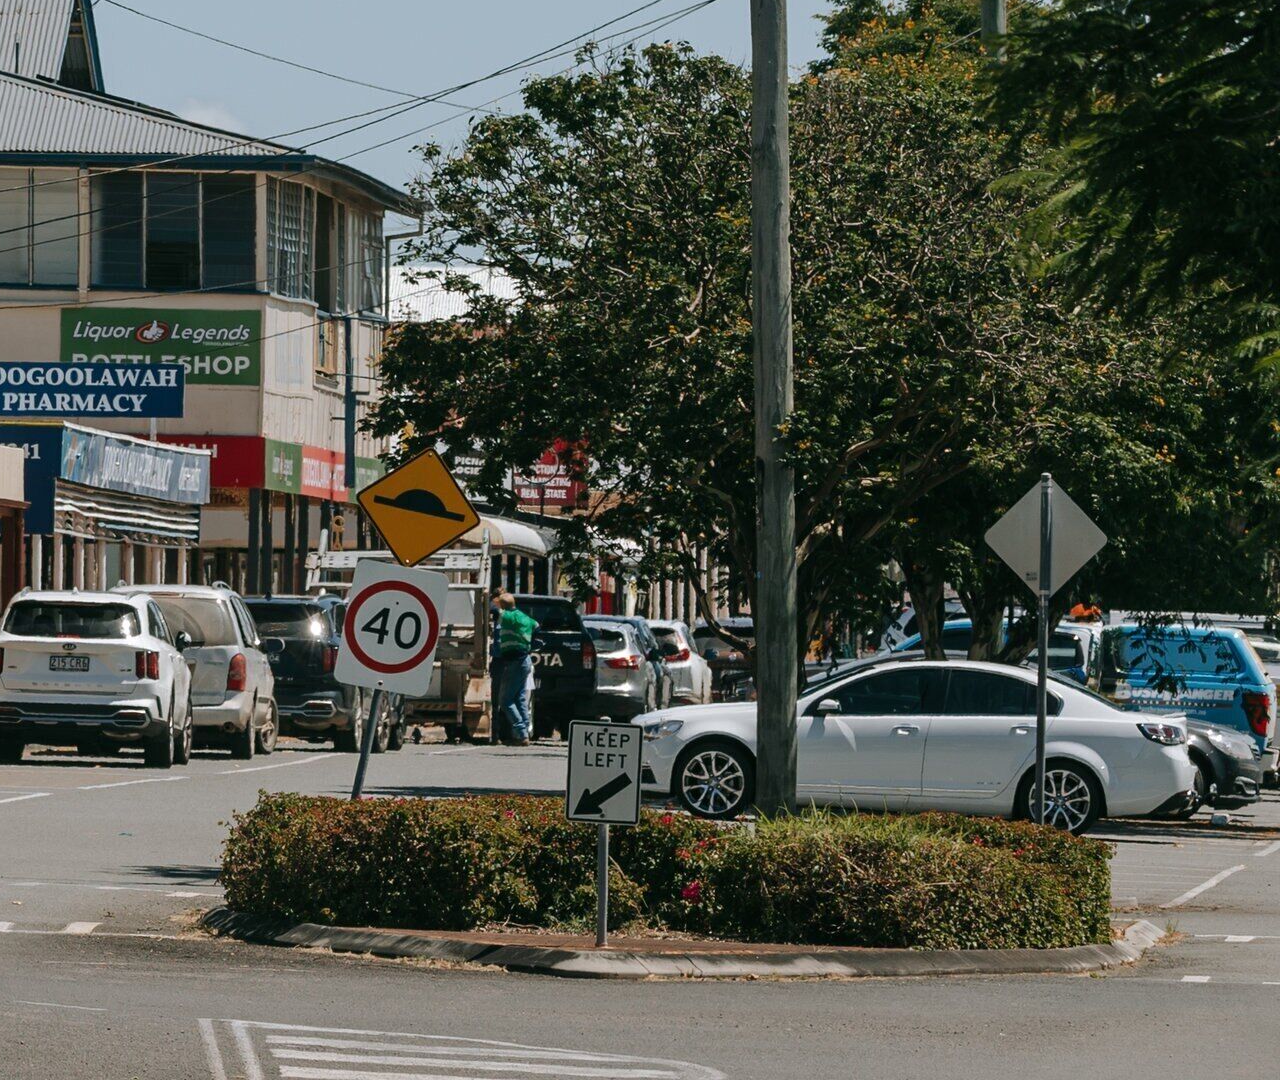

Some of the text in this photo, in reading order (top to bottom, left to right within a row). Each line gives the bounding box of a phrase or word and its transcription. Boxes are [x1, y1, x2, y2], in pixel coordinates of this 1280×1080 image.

[73, 321, 250, 343] Liquor Legends
[2, 392, 147, 412] PHARMACY
[541, 489, 567, 499] STATE
[361, 607, 422, 650] 40
[51, 657, 67, 667] 215
[530, 652, 564, 667] OTA
[584, 731, 631, 748] KEEP
[584, 752, 627, 769] LEFT
